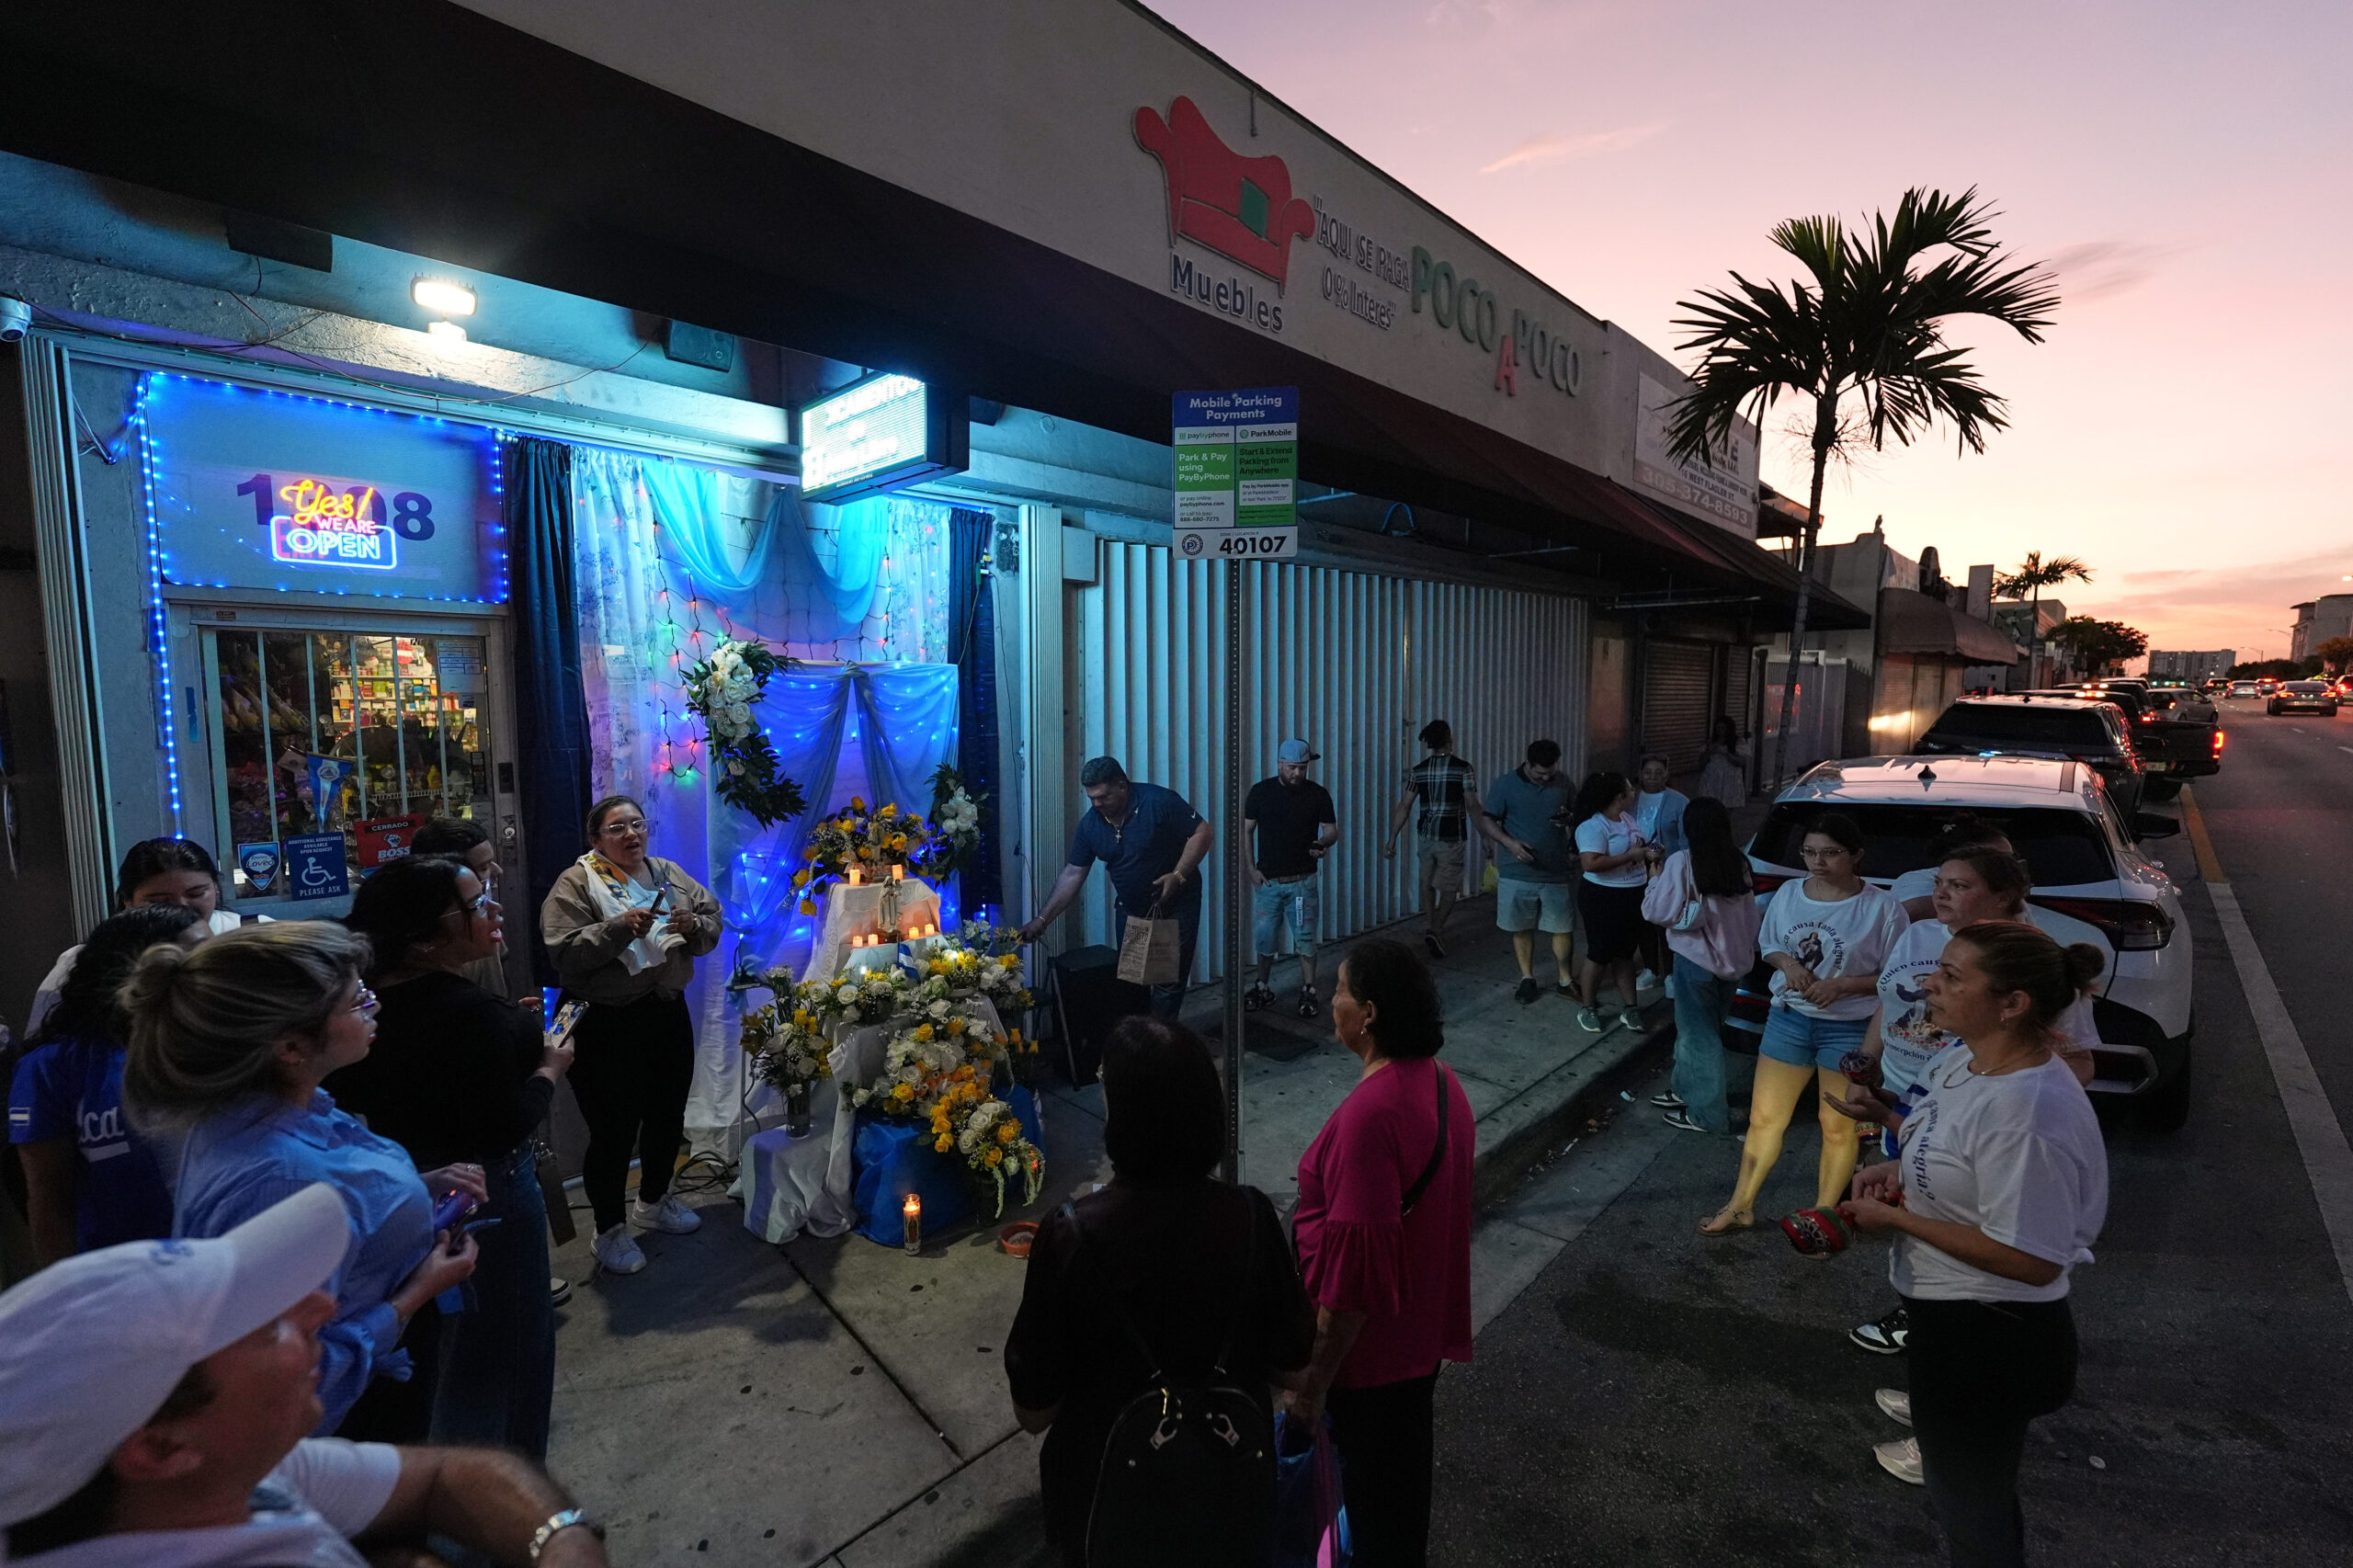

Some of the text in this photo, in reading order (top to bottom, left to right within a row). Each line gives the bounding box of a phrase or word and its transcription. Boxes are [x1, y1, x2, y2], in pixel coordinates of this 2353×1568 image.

[1357, 234, 1374, 273] SE
[1376, 244, 1412, 292] PAGA
[1170, 252, 1285, 334] Muebles
[1412, 244, 1498, 353] POCO
[1514, 308, 1582, 397] POCO
[1495, 334, 1518, 397] A
[1189, 395, 1282, 408] Mobile Parking
[1206, 409, 1266, 422] Payments
[1188, 432, 1230, 441] paybyphone
[1251, 429, 1292, 437] ParkMobile
[1179, 453, 1199, 461] Park
[1211, 453, 1227, 462] Pay
[1239, 448, 1258, 456] Start
[1266, 446, 1292, 454] Extend
[1179, 463, 1203, 472] using
[1239, 456, 1290, 466] Parking from
[1179, 472, 1230, 482] PayByPhone
[1239, 466, 1279, 475] Anywhere
[279, 479, 374, 525] Yes!
[1642, 467, 1748, 525] 305-374-8593
[315, 516, 376, 535] WE ARE
[286, 528, 381, 560] OPEN
[1220, 536, 1288, 555] 40107
[371, 821, 409, 832] CERRADO
[378, 845, 412, 859] BOSS
[300, 885, 341, 896] PLEASE ASK
[1910, 959, 1941, 968] caus
